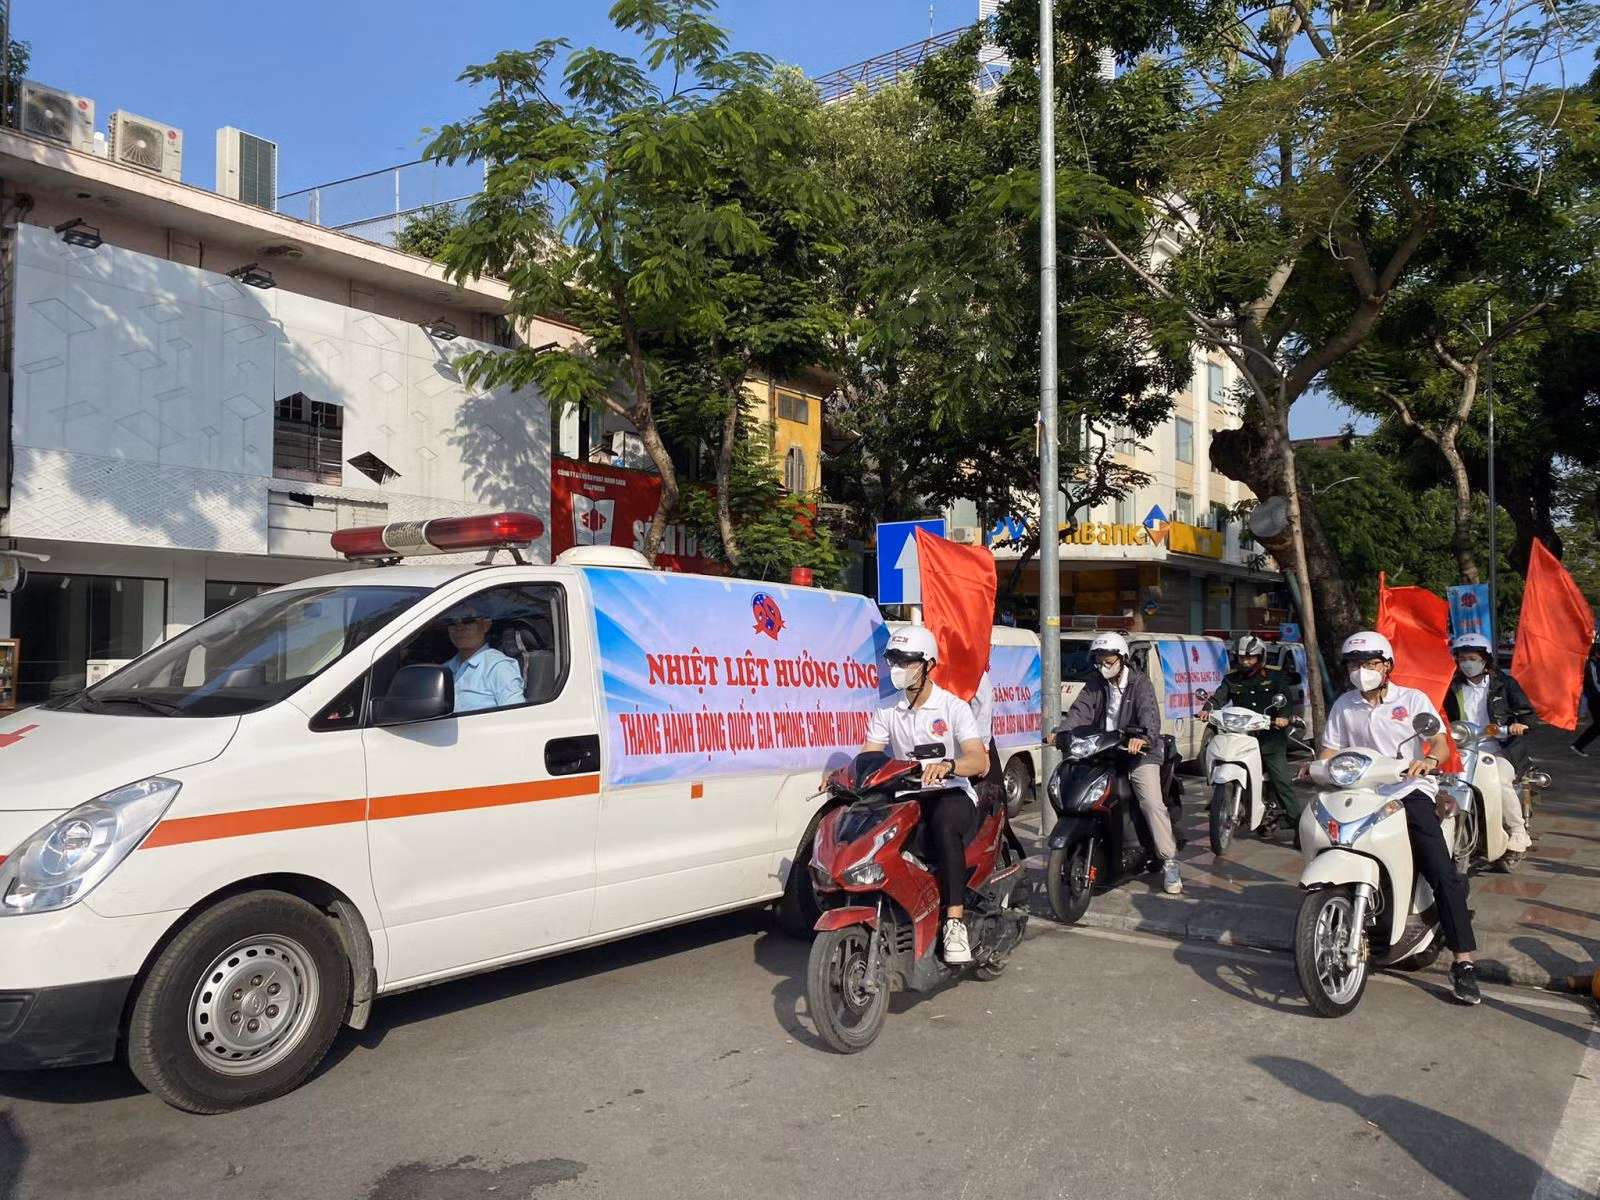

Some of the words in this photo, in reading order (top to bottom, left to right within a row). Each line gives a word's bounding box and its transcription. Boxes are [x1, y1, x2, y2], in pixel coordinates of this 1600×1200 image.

[646, 646, 719, 694] NHIỆT
[724, 648, 769, 695] LIỆT
[774, 649, 840, 688] HƯỞNG
[843, 655, 879, 689] ỨNG
[1014, 686, 1031, 704] TẠO
[618, 704, 661, 755] THÁNG
[662, 704, 695, 754] HÀNH
[696, 704, 727, 761] ĐỘNG
[728, 698, 755, 755] QUỐC
[756, 711, 774, 750] GIA
[774, 702, 806, 749] PHÒNG
[806, 699, 836, 748] CHỐNG
[836, 711, 869, 746] HIV/AIDS
